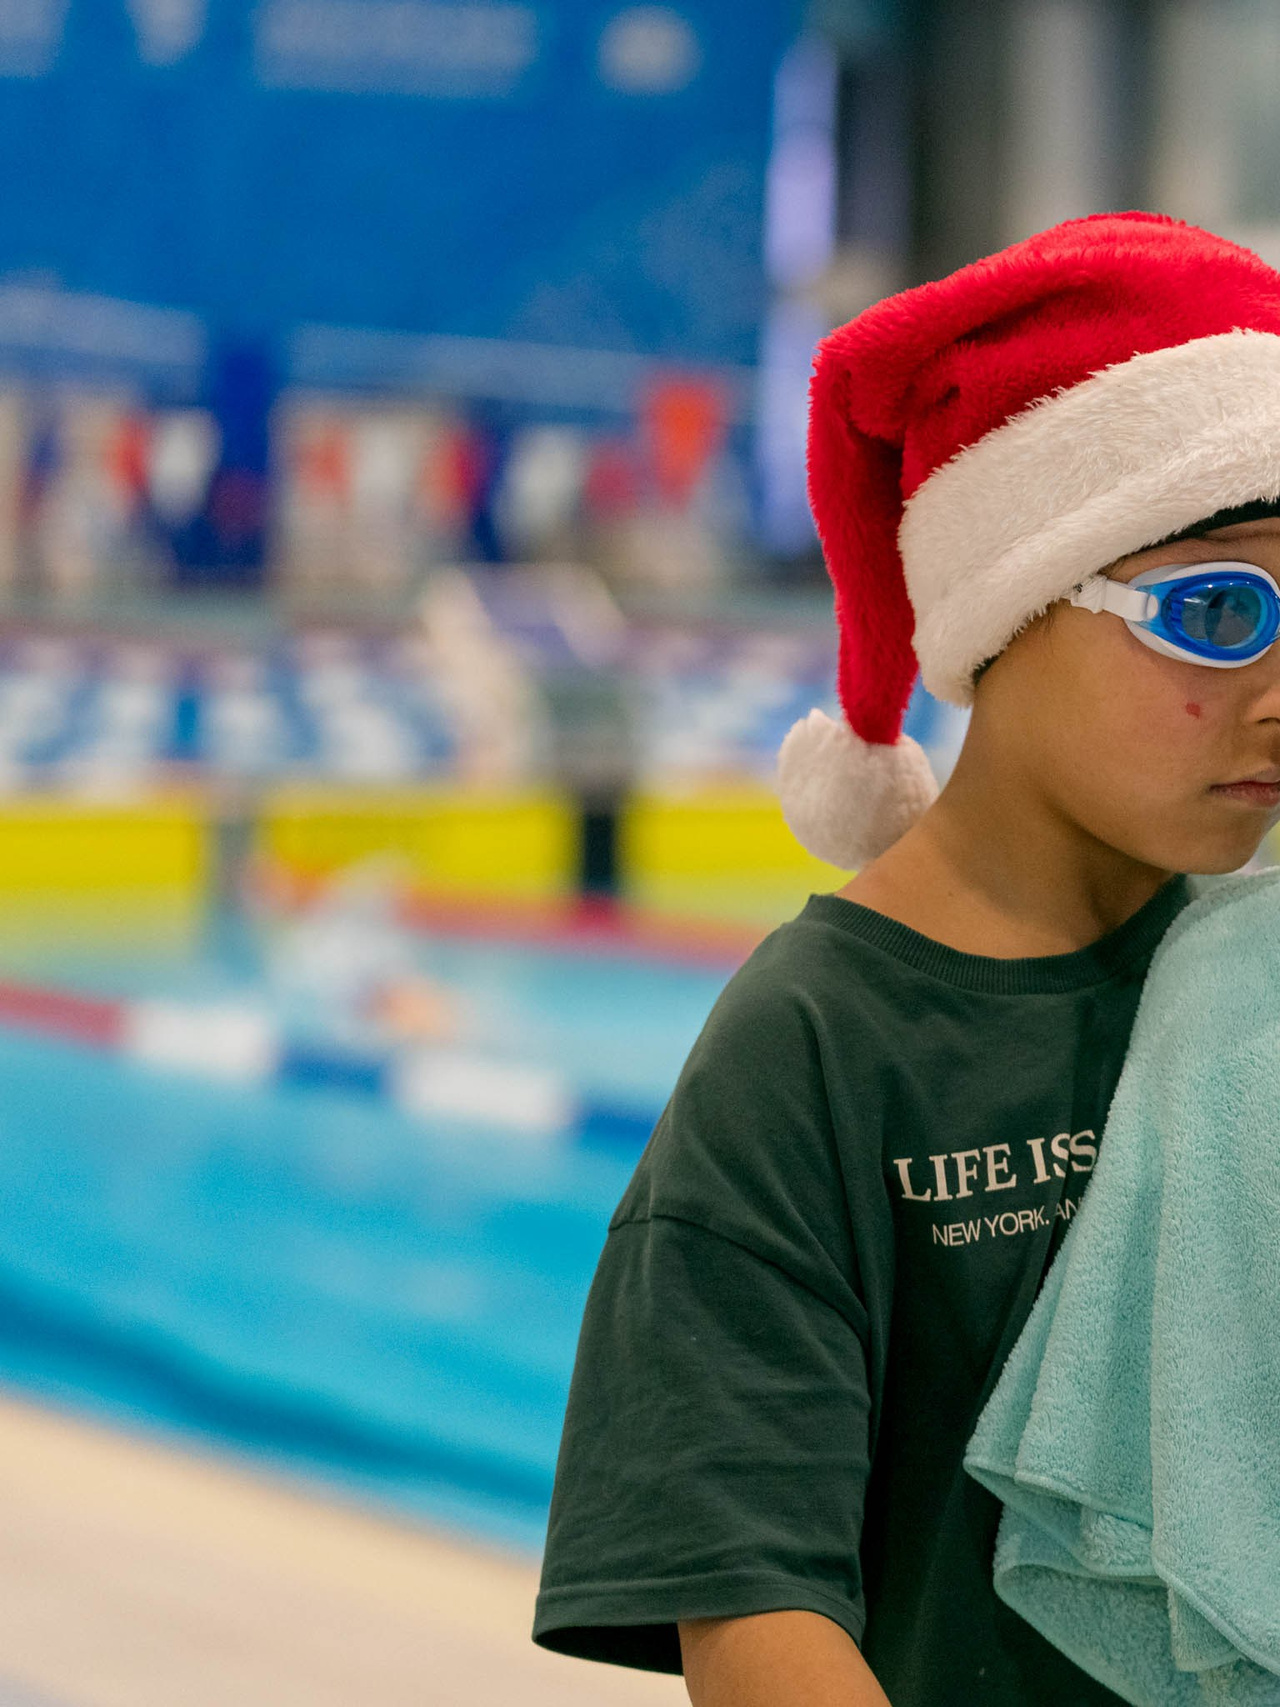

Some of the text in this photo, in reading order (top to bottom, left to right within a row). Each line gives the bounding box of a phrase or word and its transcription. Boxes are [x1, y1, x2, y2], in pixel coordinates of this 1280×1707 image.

[893, 1142, 1017, 1202] LIFE
[932, 1218, 981, 1247] NEW
[984, 1205, 1050, 1238] YORK.
